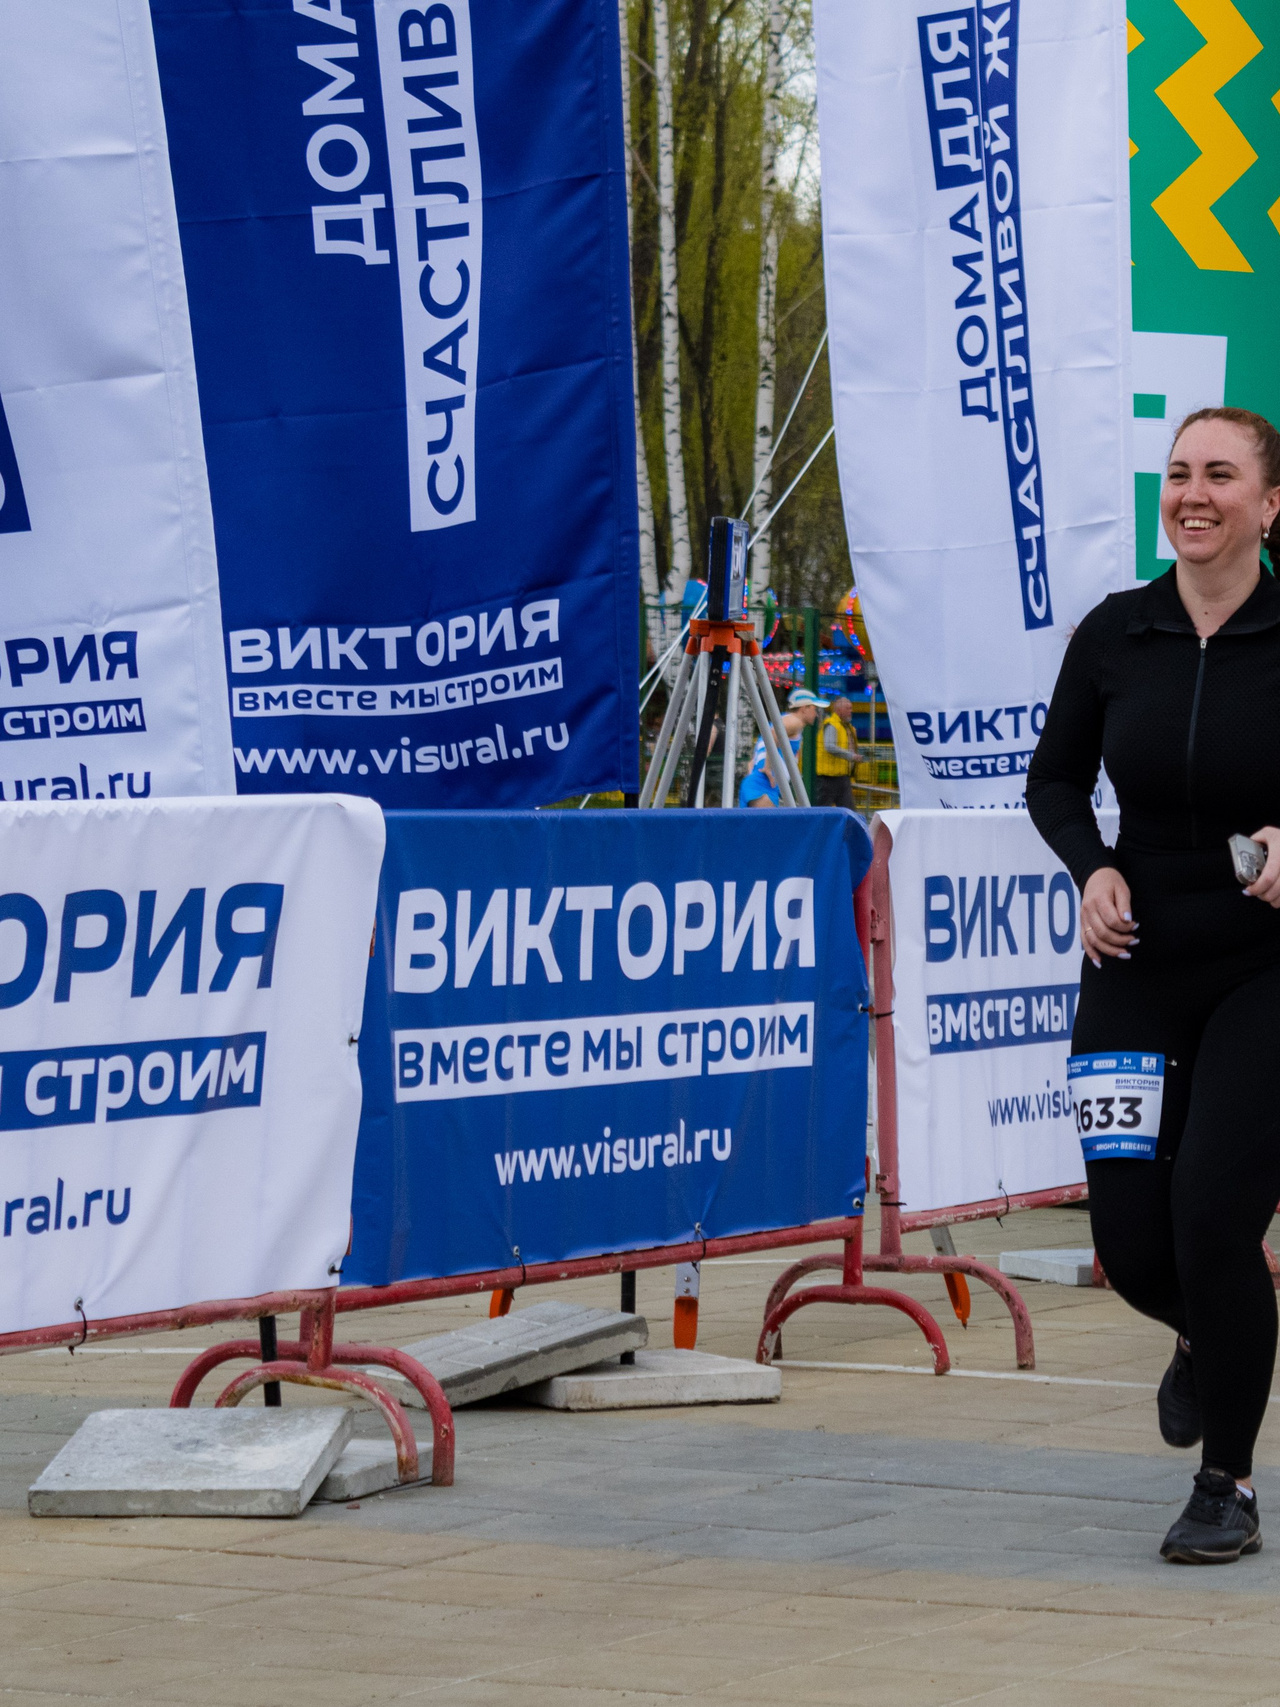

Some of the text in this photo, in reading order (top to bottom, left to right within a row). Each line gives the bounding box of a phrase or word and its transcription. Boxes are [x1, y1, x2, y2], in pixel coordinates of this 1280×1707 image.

[927, 17, 999, 423] ДОМА ДЛЯ
[982, 0, 1048, 620] СЧАСТЛИВОЙ Ж
[0, 630, 139, 688] РИЯ
[229, 598, 560, 674] ВИКТОРИЯ
[238, 661, 559, 712] вместе мы строим
[3, 703, 143, 738] строим
[233, 722, 570, 776] www.visural.ru
[906, 701, 1051, 746] ВИКТО
[925, 756, 1010, 777] вместе
[393, 876, 816, 994] ВИКТОРИЯ
[924, 871, 1084, 963] ВИКТО
[928, 995, 1026, 1046] вместе
[1031, 992, 1068, 1034] мы
[399, 1013, 809, 1089] вместе мы строим
[25, 1043, 259, 1123] строим
[987, 1079, 1074, 1128] www.visu
[1115, 1078, 1160, 1087] ВИКТОРИЯ
[494, 1118, 732, 1186] www.visural.ru
[3, 1176, 132, 1238] ral.ru
